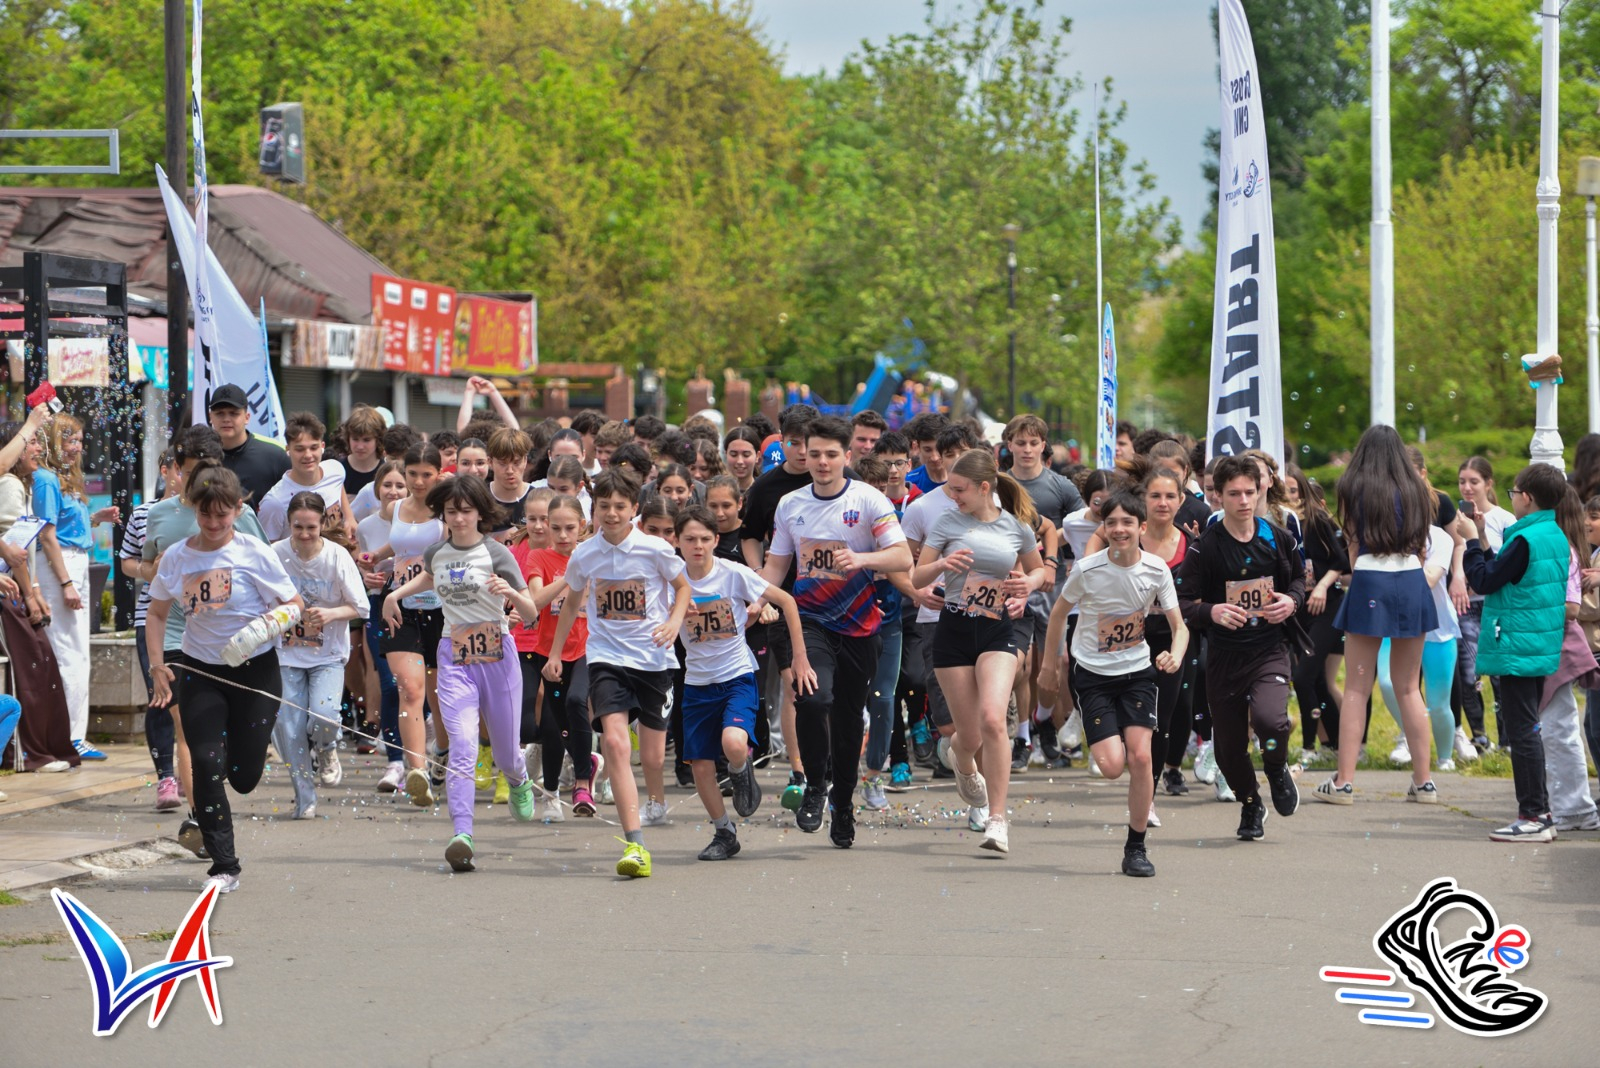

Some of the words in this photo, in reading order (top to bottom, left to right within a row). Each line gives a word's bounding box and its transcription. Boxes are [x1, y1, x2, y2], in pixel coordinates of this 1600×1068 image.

[813, 549, 833, 569] 80
[200, 581, 210, 602] 8
[605, 590, 636, 612] 108
[974, 585, 998, 608] 26
[1241, 589, 1261, 609] 99
[700, 611, 721, 632] 75
[1113, 622, 1134, 643] 32
[468, 634, 487, 655] 13
